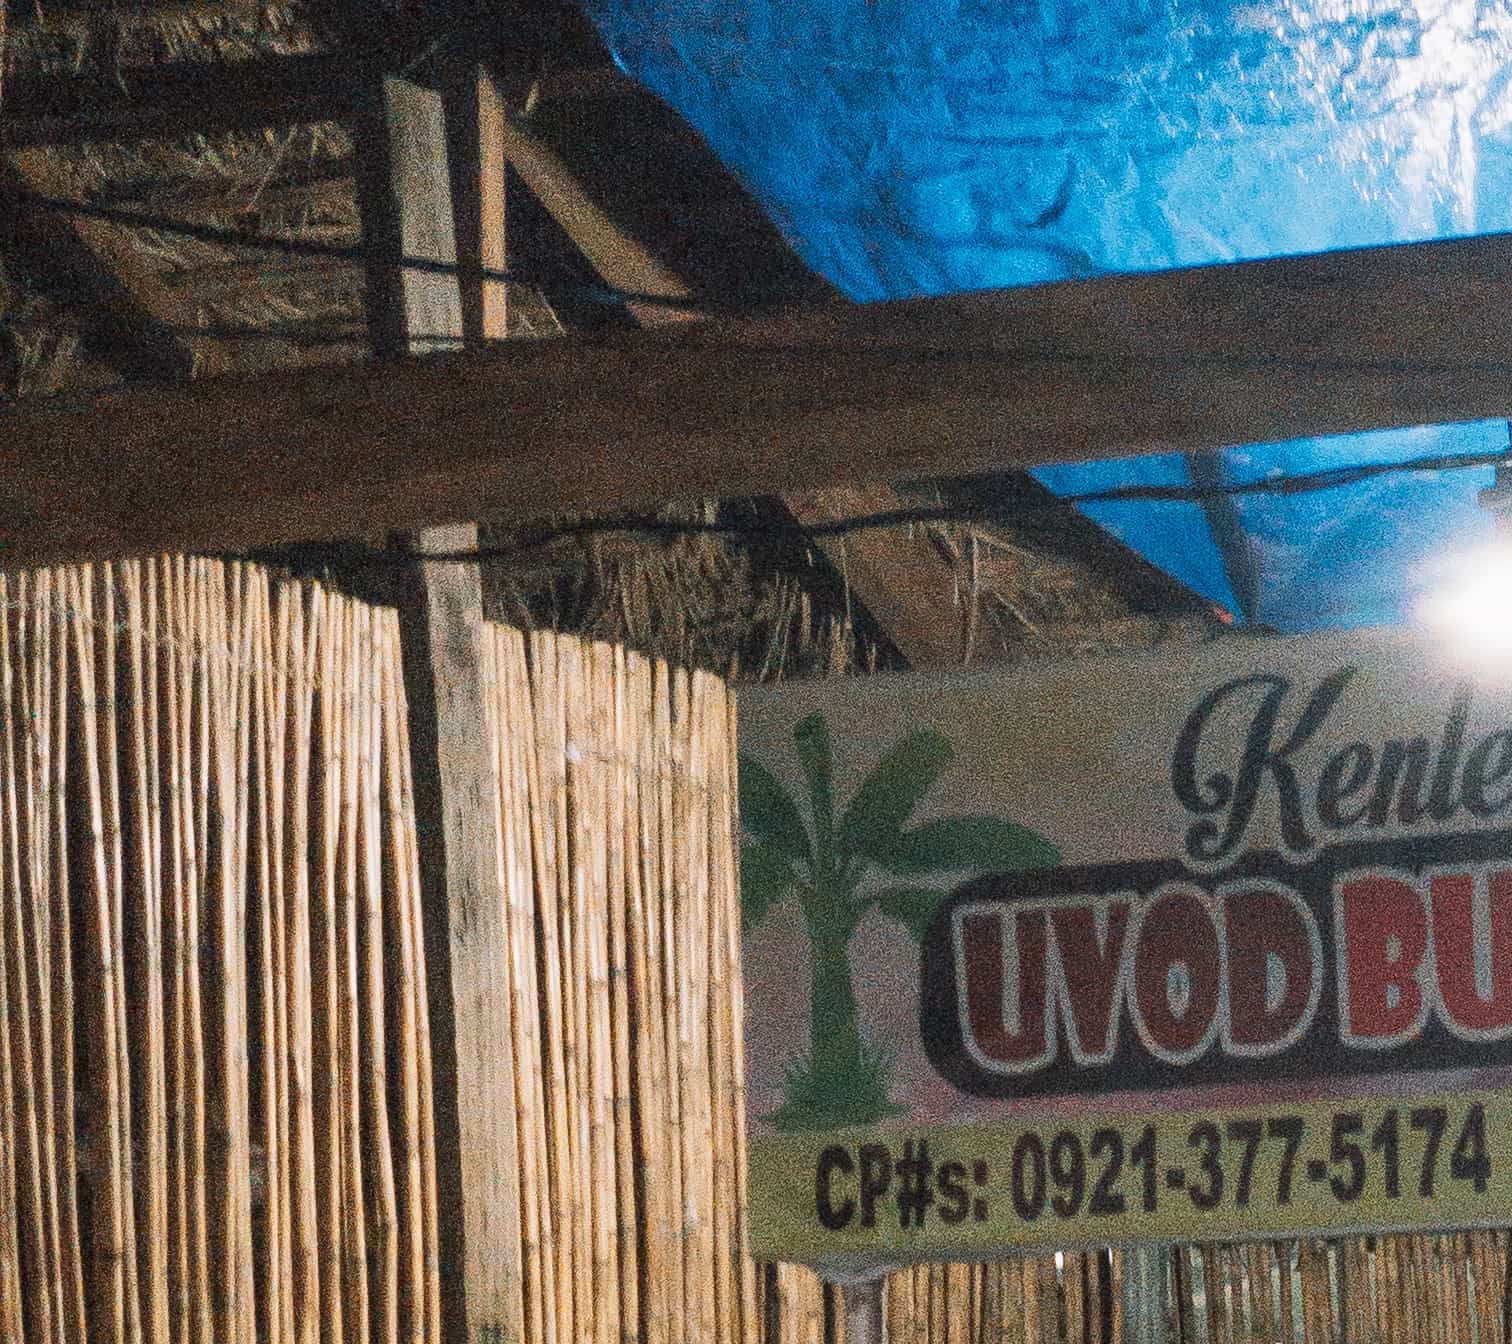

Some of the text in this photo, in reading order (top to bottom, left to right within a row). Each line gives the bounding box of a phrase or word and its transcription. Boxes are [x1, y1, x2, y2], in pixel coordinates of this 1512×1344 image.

[952, 876, 1323, 1077] UVOD
[814, 1141, 989, 1234] CP#s:
[1010, 1102, 1491, 1226] 0921-377-5174
